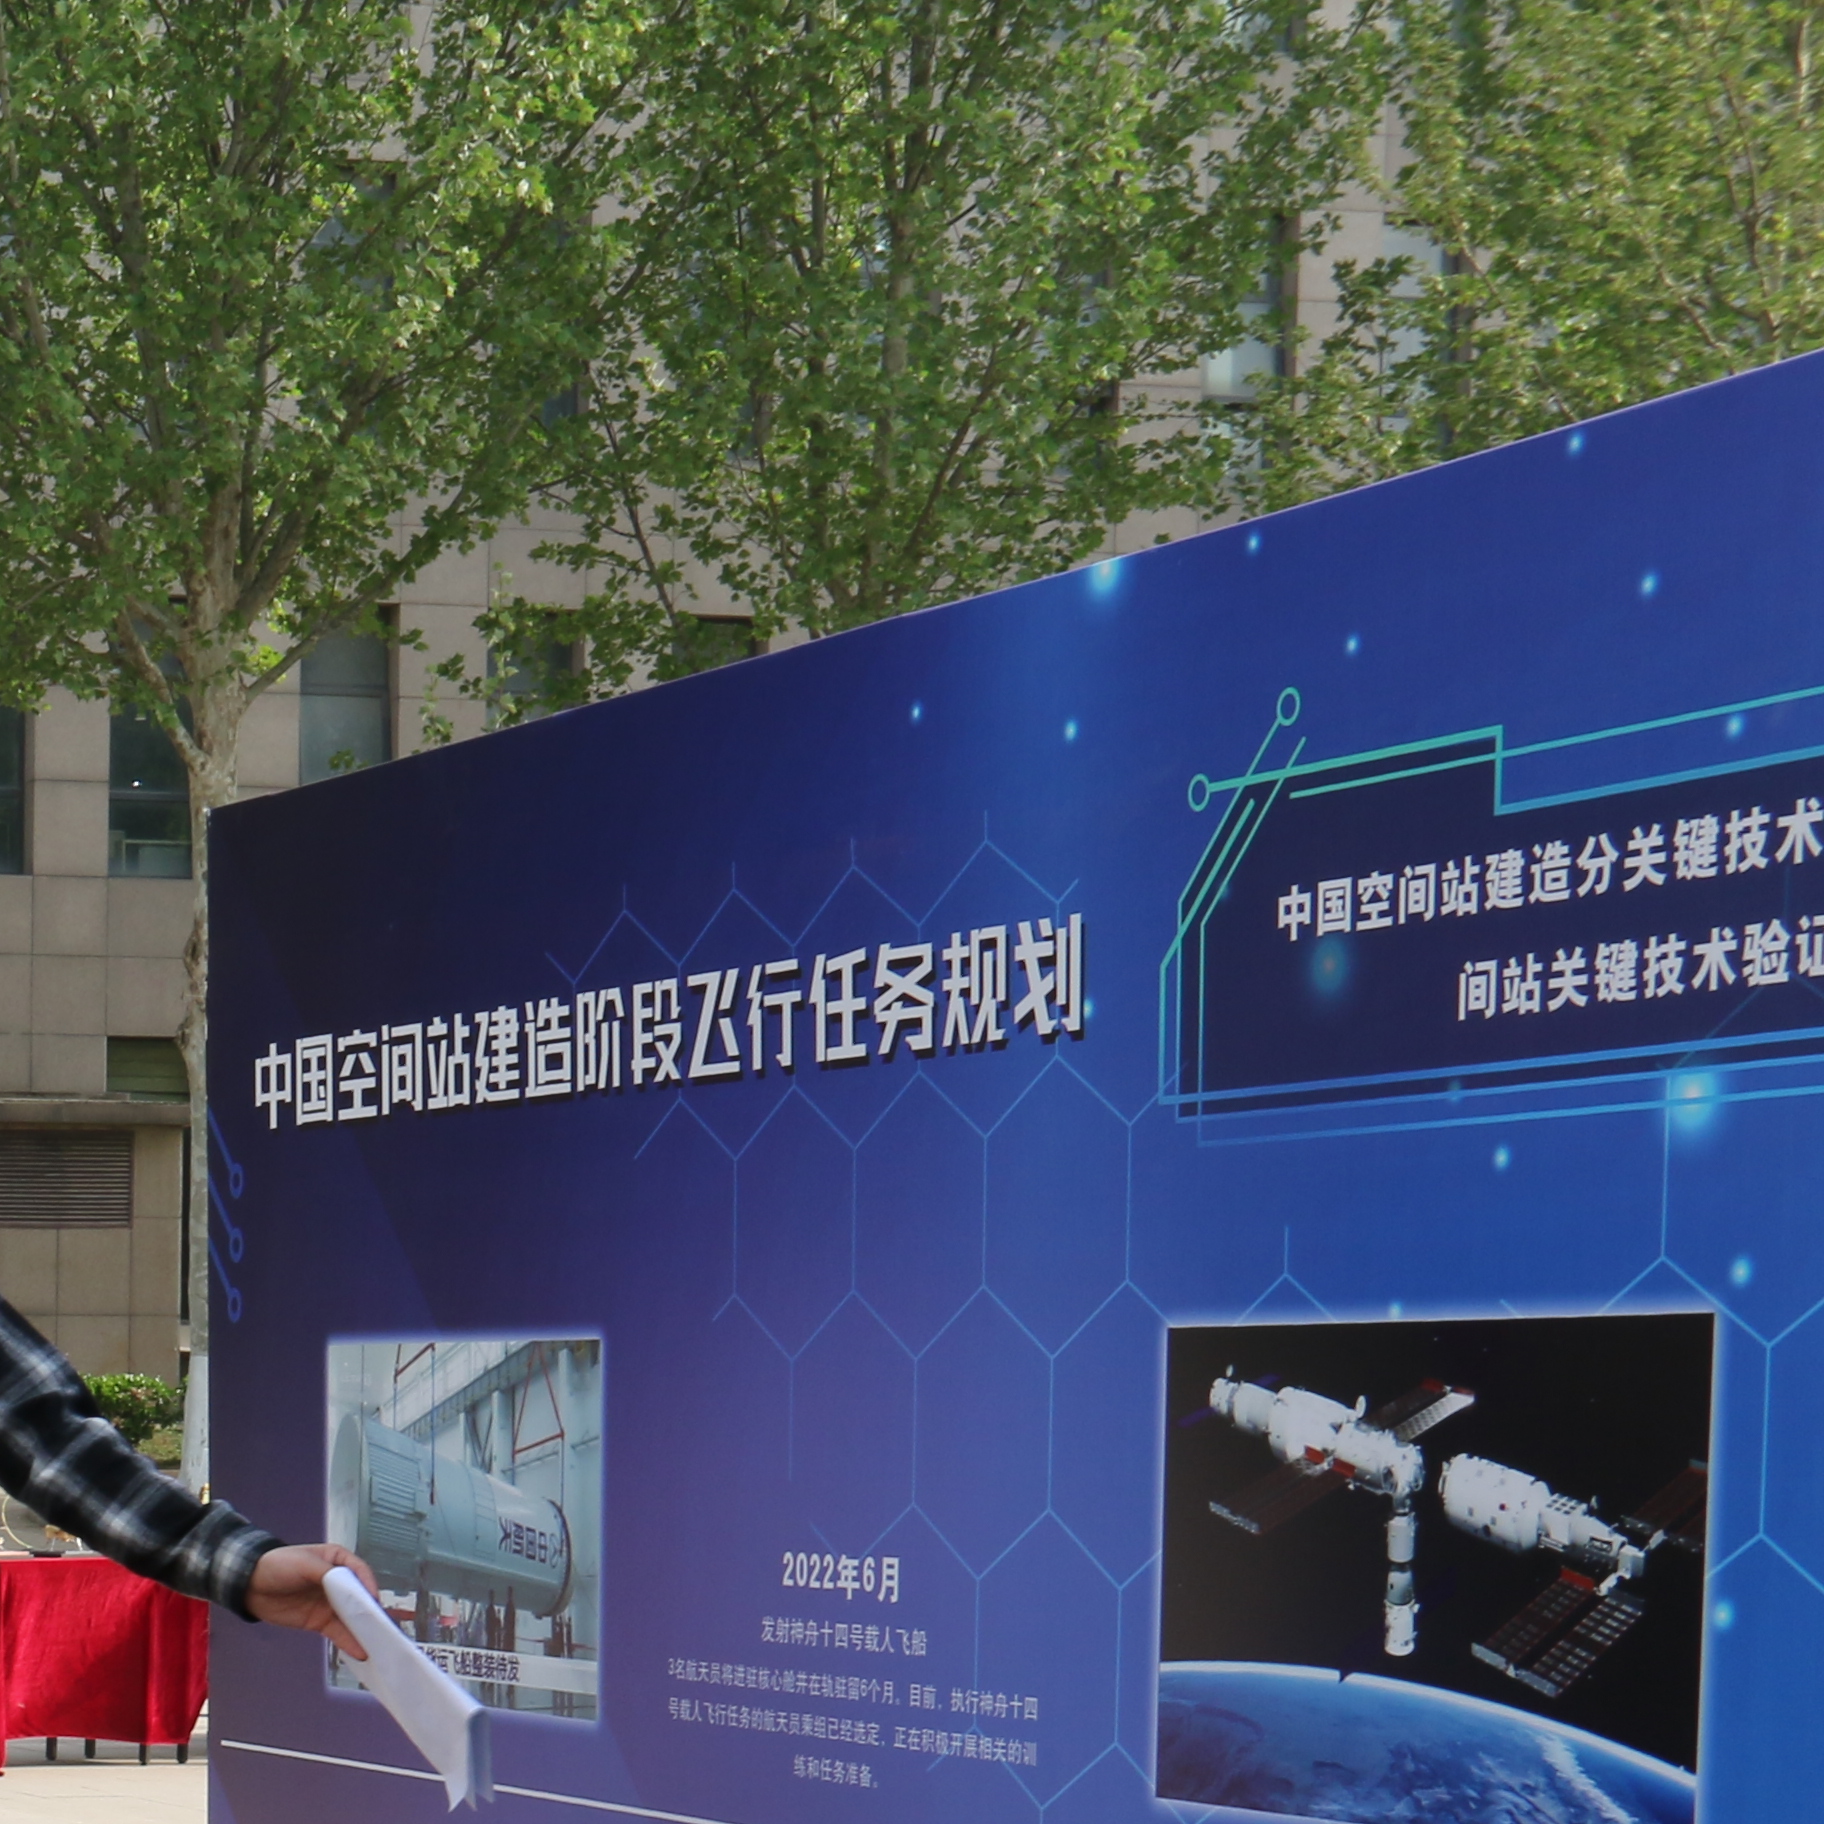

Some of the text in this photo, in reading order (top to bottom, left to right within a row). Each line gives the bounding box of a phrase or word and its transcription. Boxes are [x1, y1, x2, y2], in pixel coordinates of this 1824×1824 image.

[1277, 797, 1824, 942] 中国空间站建造分关键技术
[1457, 914, 1824, 1021] 间站关键技术验证
[253, 912, 1086, 1131] 中国空间站建造阶段飞行任务规划
[782, 1551, 901, 1604] 2022年6月
[761, 1615, 927, 1657] 发射神舟十四号载人飞船
[792, 1754, 880, 1789] 练和任务准备。
